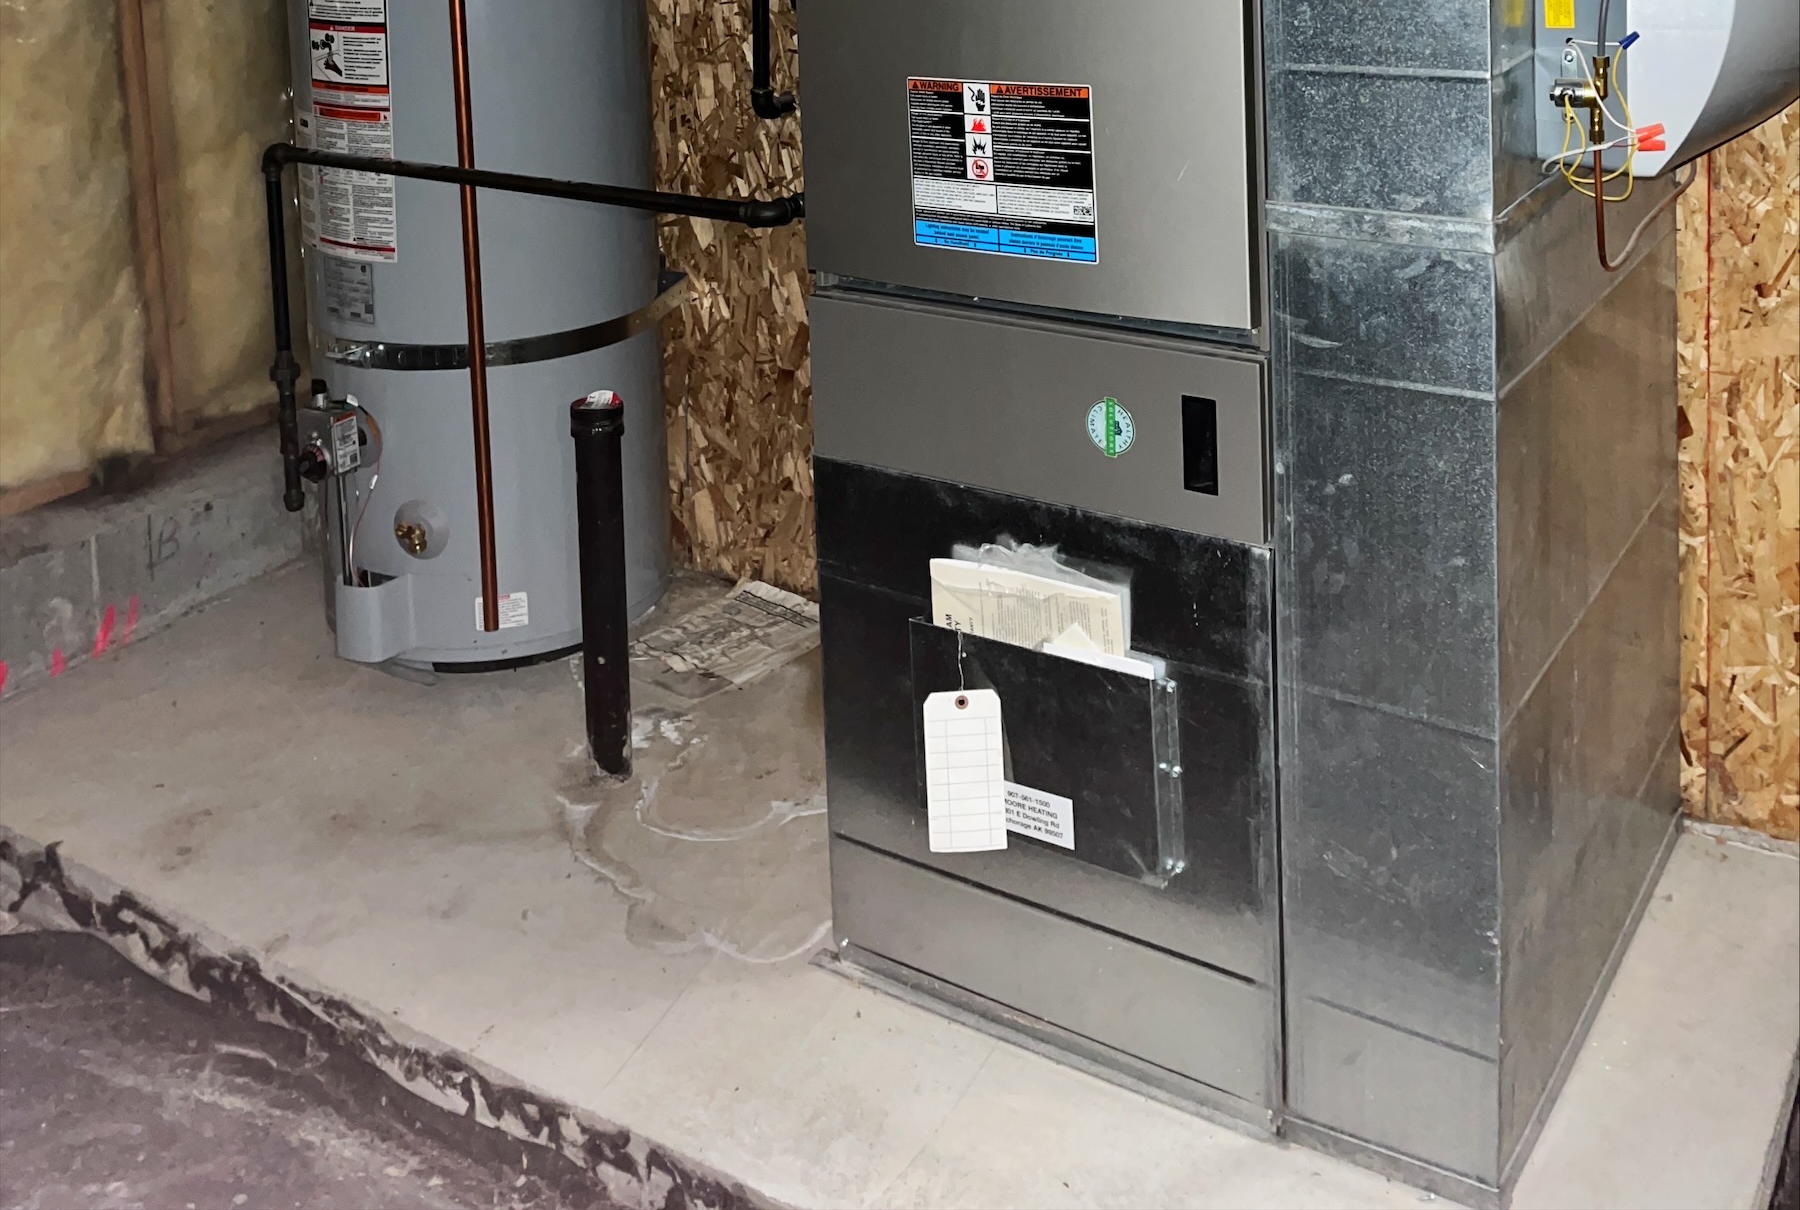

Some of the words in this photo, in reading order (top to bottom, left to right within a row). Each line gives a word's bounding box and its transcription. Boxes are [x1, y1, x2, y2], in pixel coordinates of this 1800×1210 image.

[919, 81, 959, 91] WARNING
[1002, 86, 1082, 97] AVERTISSEMENT
[1089, 406, 1103, 445] CLIMATE
[1117, 409, 1131, 450] HEALTHY
[1007, 790, 1051, 808] 907-561-1500
[1028, 805, 1058, 819] HEATING
[1005, 817, 1032, 829] chorage
[1022, 812, 1049, 826] Dowling
[1050, 820, 1060, 829] Rd
